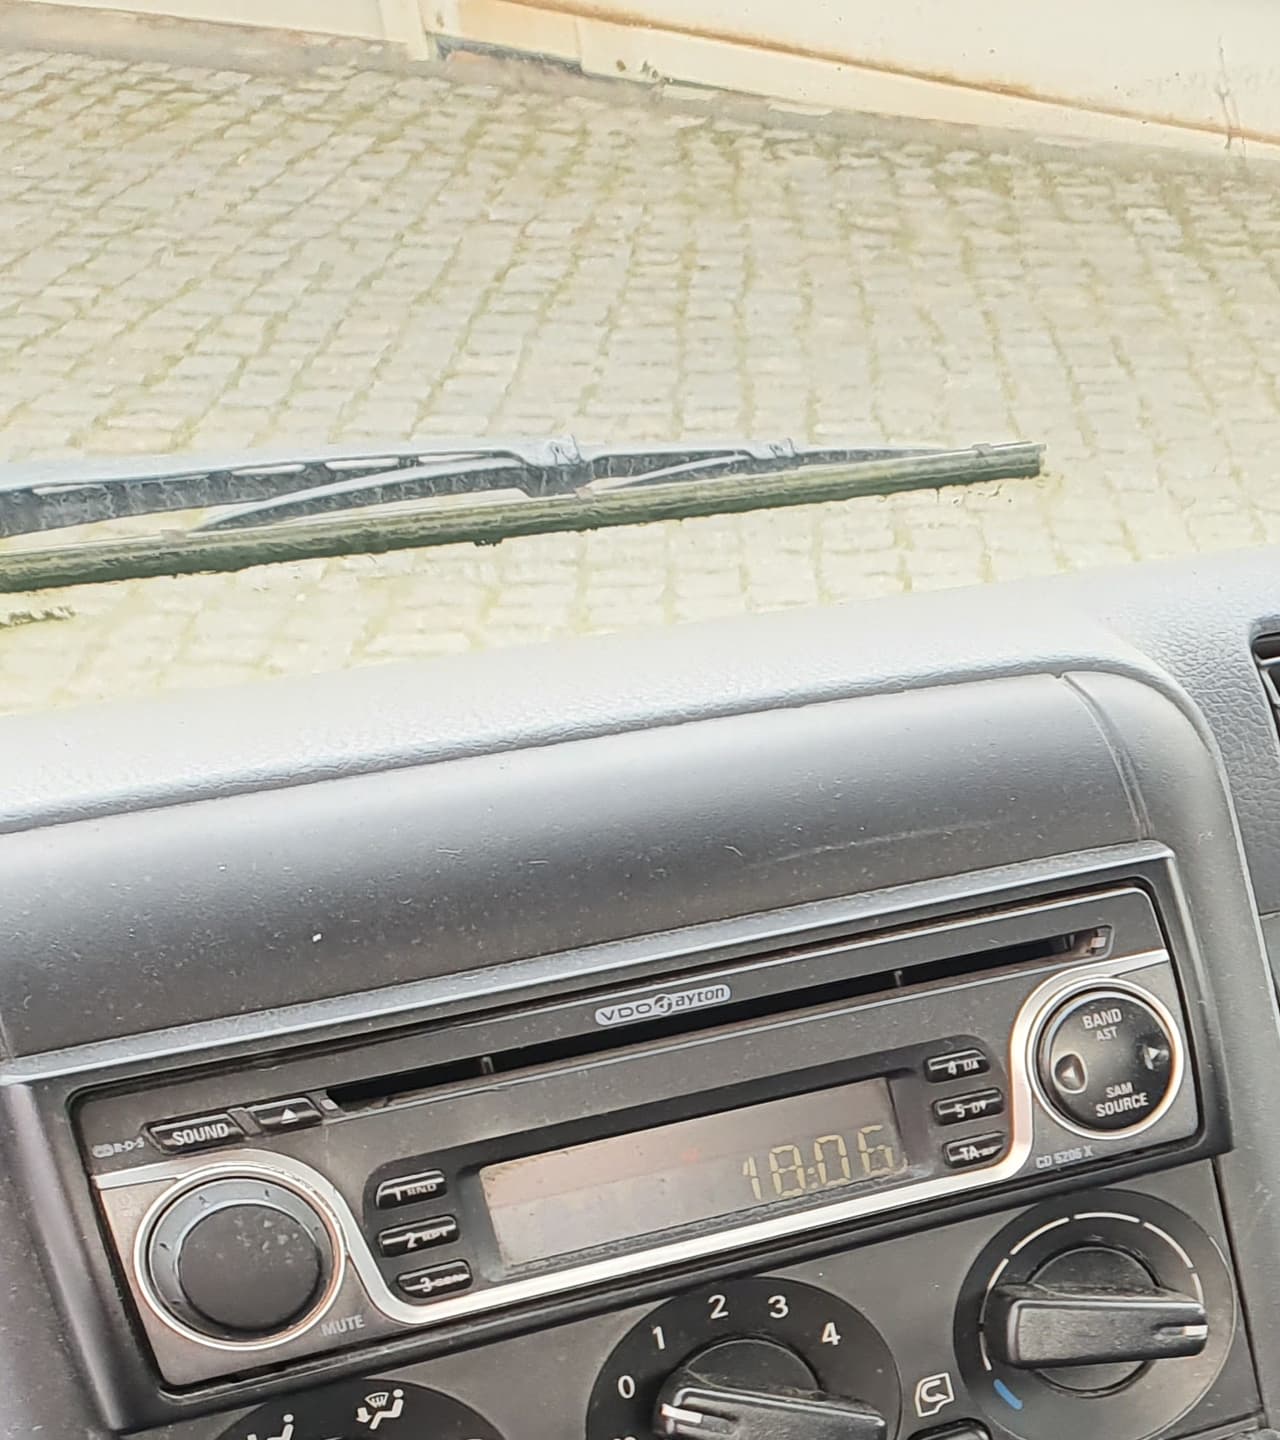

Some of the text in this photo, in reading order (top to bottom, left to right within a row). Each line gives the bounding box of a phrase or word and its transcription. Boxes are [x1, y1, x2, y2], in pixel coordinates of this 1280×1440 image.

[1082, 1008, 1123, 1029] BAND
[1096, 1027, 1118, 1041] AST
[1106, 1082, 1133, 1098] SAM
[1096, 1093, 1149, 1117] SOURCE
[172, 1123, 229, 1146] SOUND
[742, 1125, 894, 1200] 18:06
[959, 1145, 980, 1160] TA
[1036, 1155, 1052, 1168] CD
[420, 1277, 433, 1292] 3
[321, 1315, 365, 1336] MUTE
[618, 1294, 841, 1398] 0 1 2 3 4
